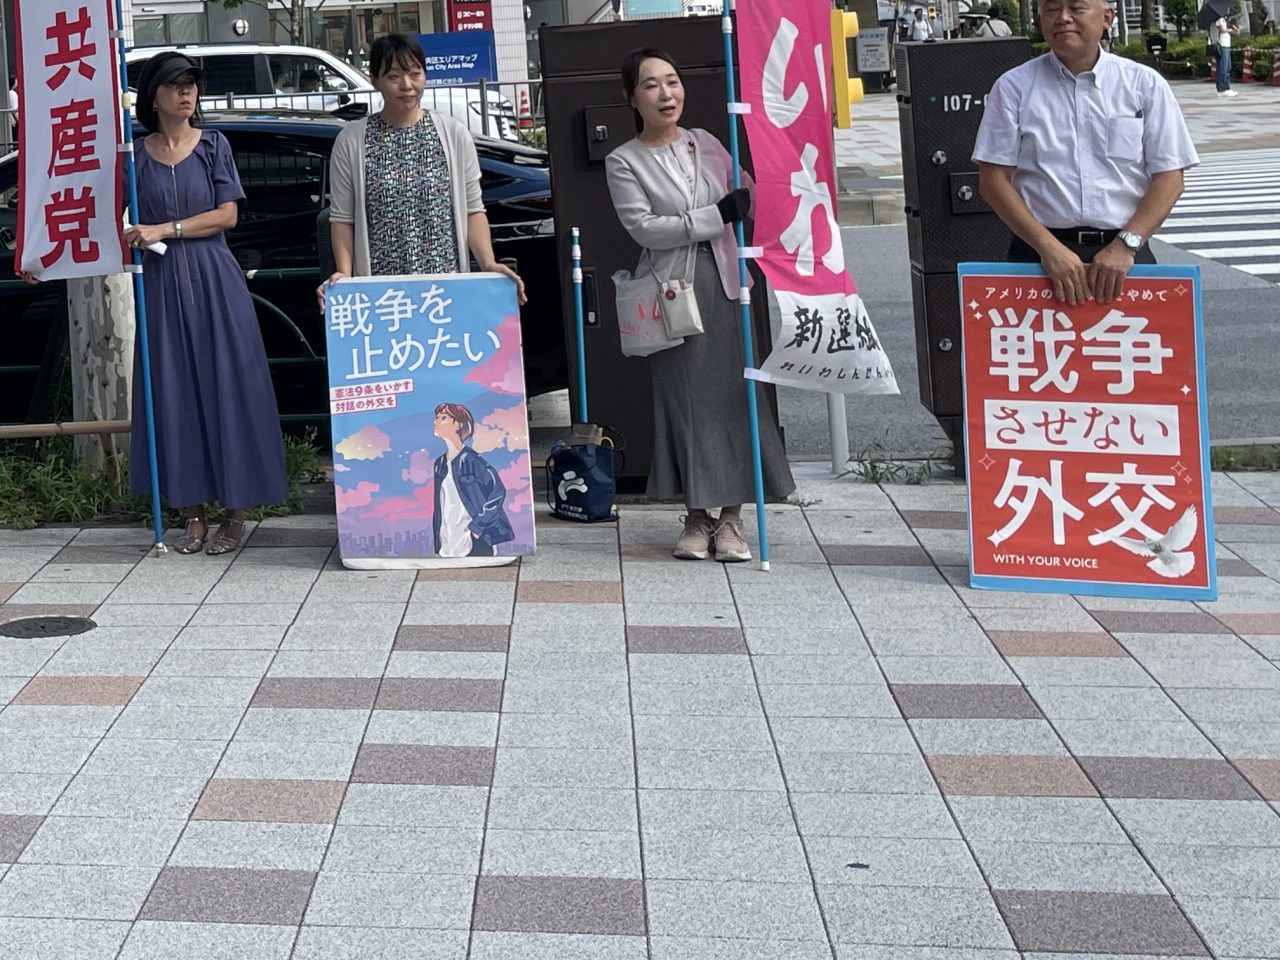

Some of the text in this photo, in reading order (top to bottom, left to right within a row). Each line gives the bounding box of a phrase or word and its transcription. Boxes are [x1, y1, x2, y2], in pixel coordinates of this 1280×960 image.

[944, 94, 990, 112] 107-
[329, 284, 453, 338] 戦争を
[345, 327, 501, 380] 止めたい
[988, 308, 1174, 395] 戦争
[335, 381, 411, 398] 憲法9条をいかす
[336, 396, 394, 412] 対話の外交を
[992, 406, 1169, 449] させない
[988, 458, 1176, 546] 外交
[993, 553, 1099, 569] WITH YOUR VOICE
